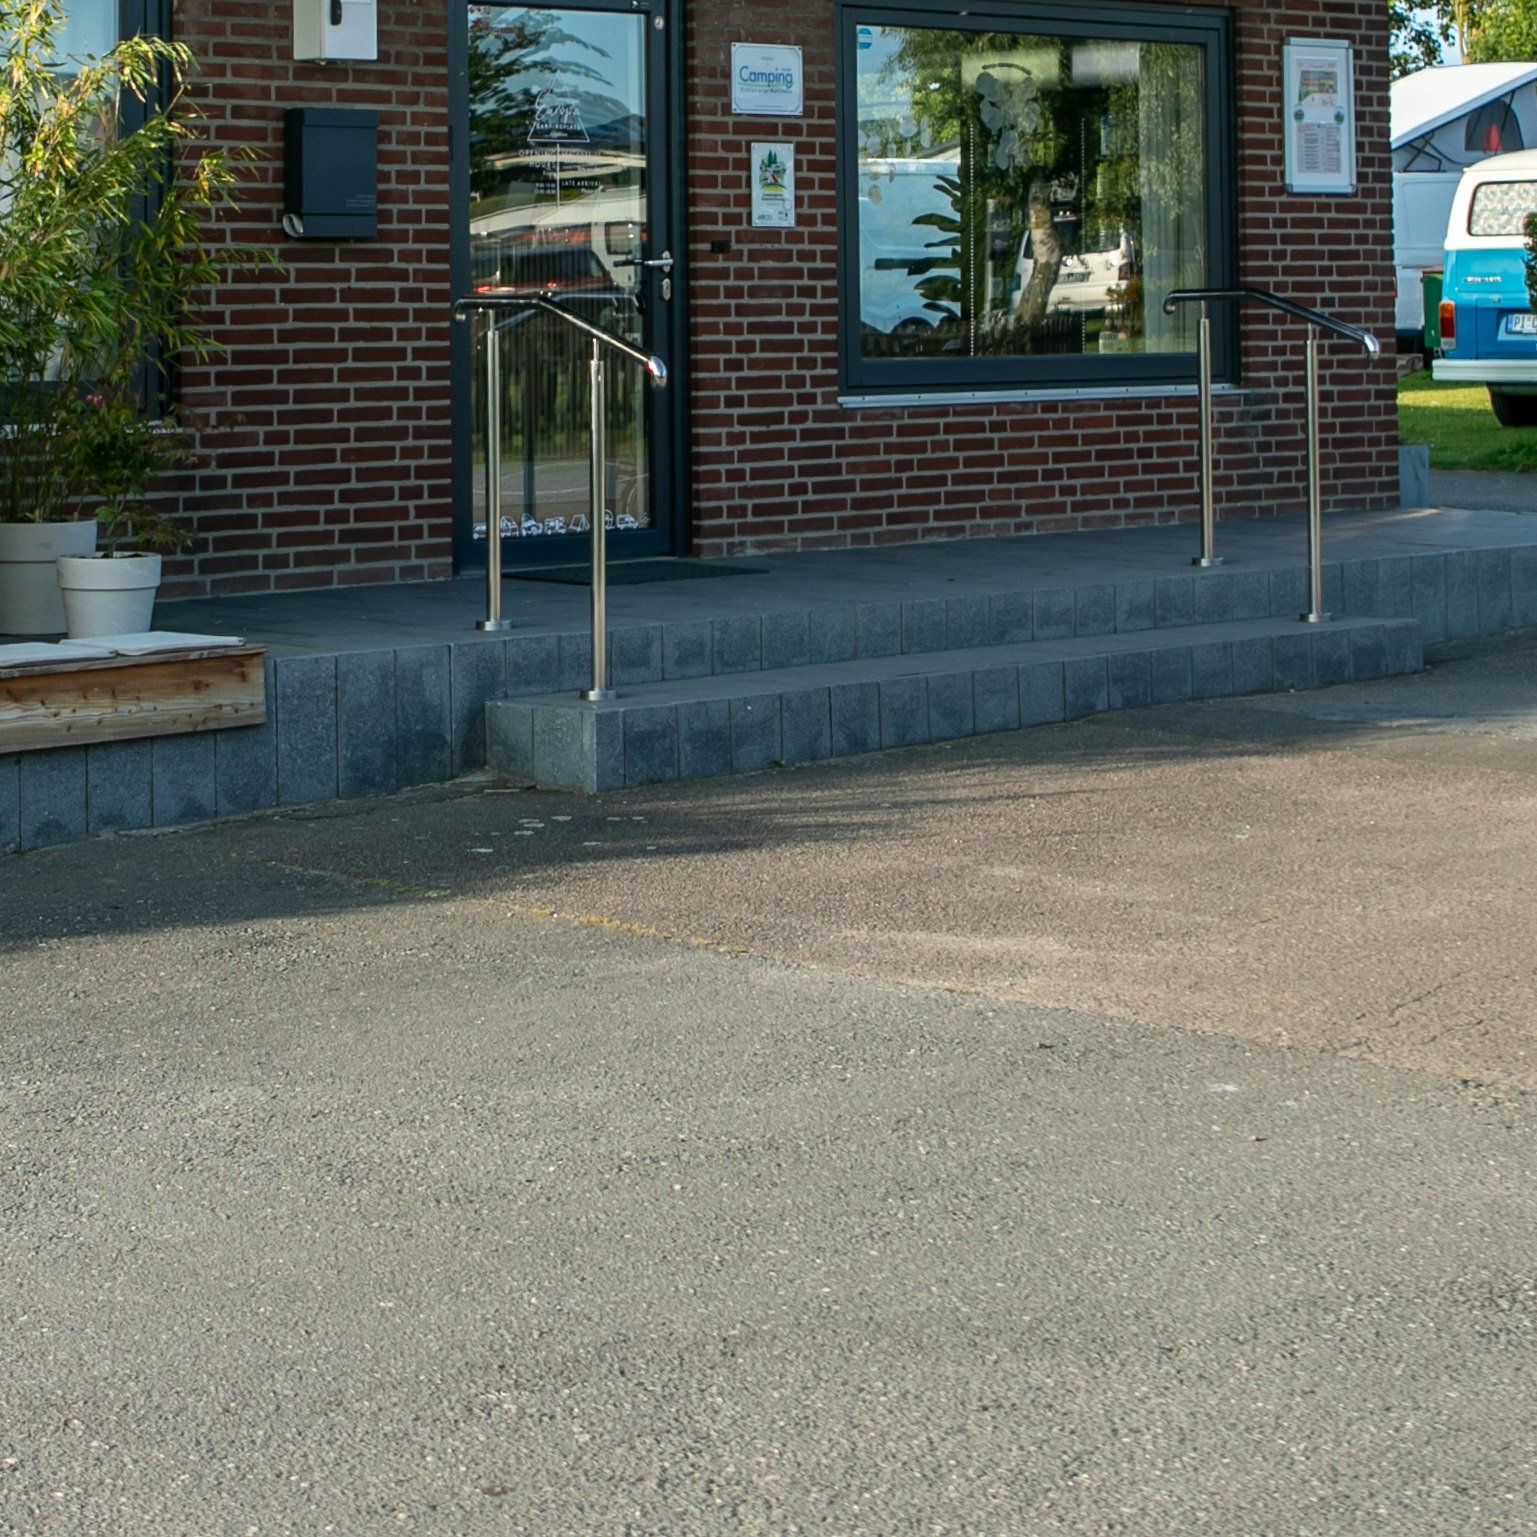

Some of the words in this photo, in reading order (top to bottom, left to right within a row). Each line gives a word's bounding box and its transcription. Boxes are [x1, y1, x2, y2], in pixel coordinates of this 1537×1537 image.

[739, 65, 794, 89] Camping
[535, 89, 581, 123] Europa
[529, 161, 557, 169] HOURS
[1514, 316, 1525, 329] PI
